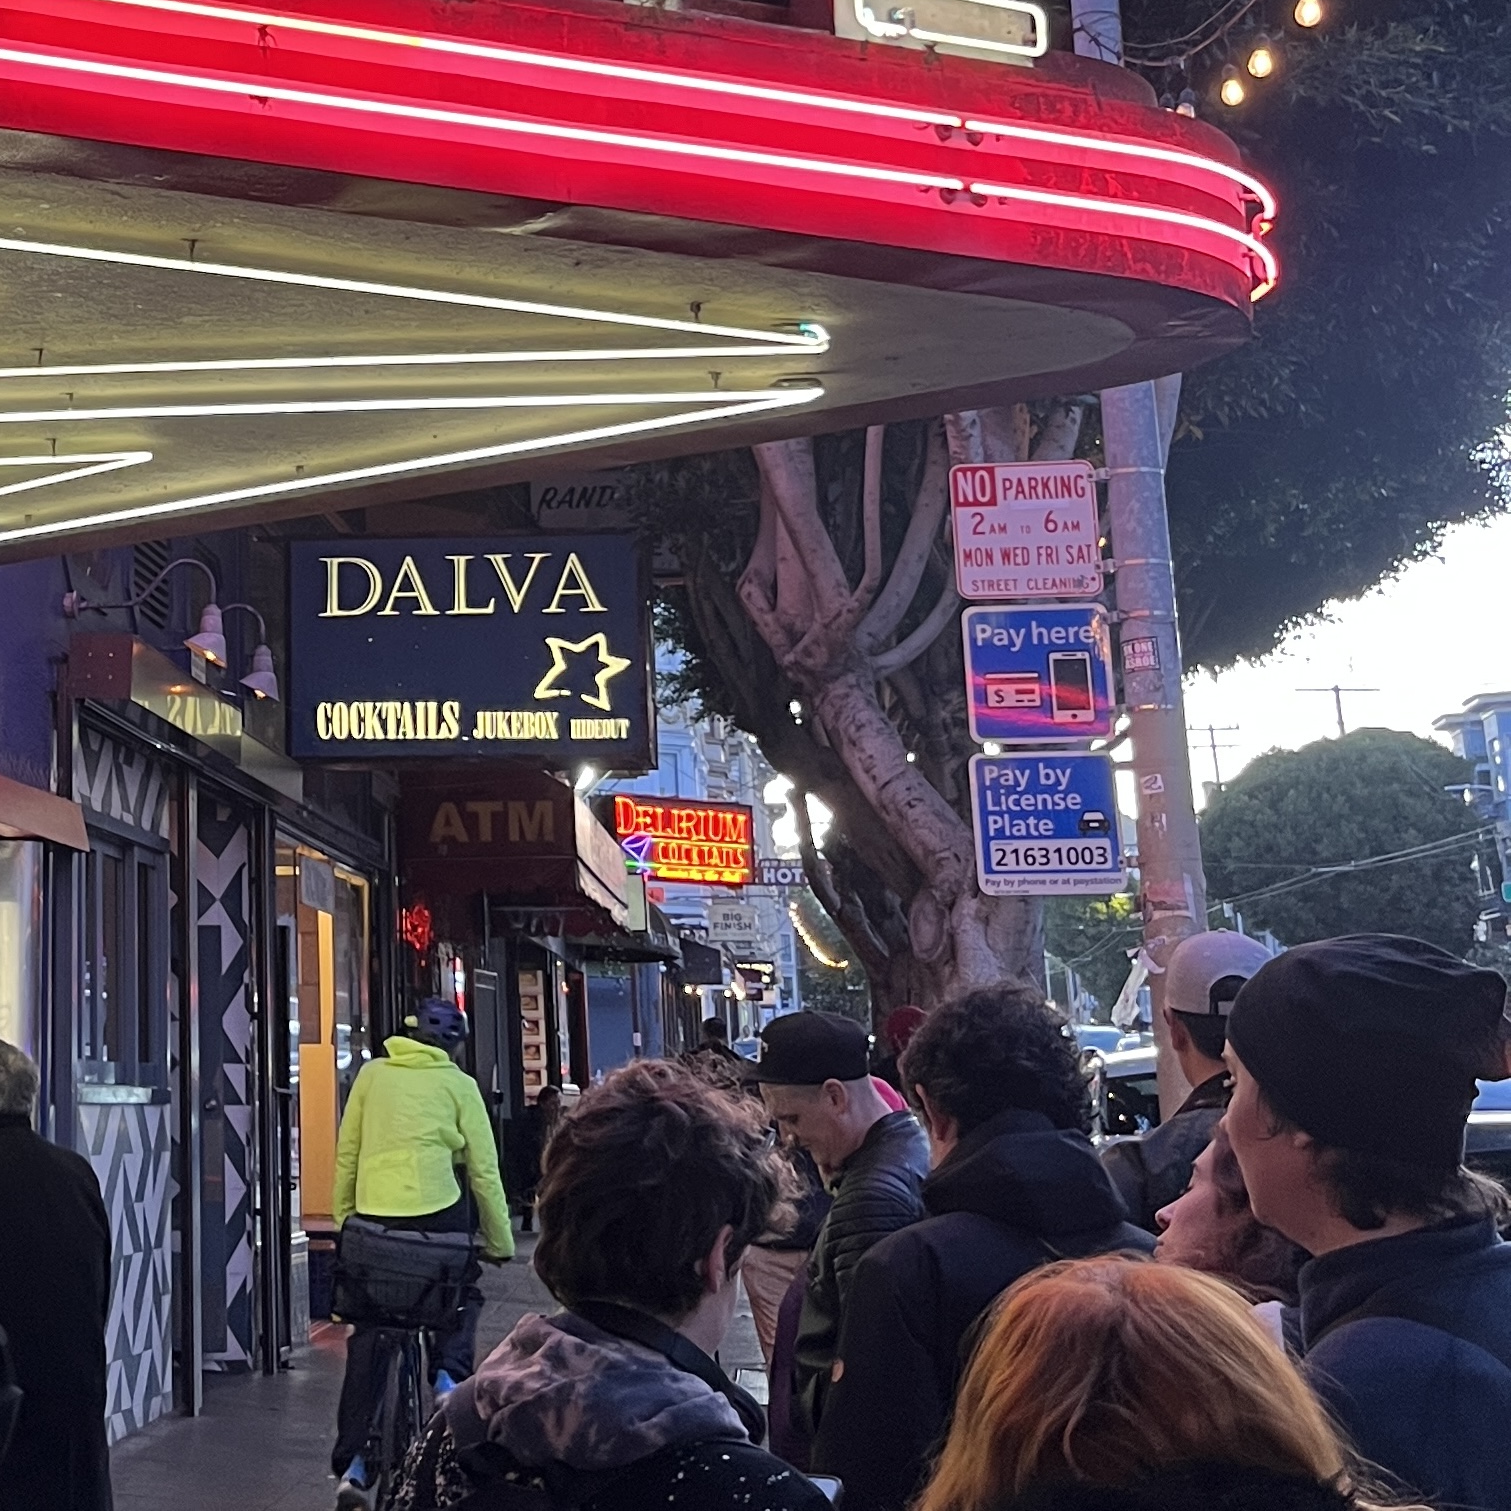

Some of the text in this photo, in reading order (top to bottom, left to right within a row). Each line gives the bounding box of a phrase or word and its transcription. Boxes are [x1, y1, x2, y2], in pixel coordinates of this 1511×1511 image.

[956, 469, 1086, 503] NO PARKING
[963, 544, 1092, 567] MON WED FRI SAT
[317, 552, 608, 617] DALVA
[972, 576, 1089, 592] STREET CLEANING
[975, 621, 1095, 651] Pay here
[317, 701, 630, 740] COCKTAILS JUKEBOX HIDEOUT
[984, 763, 1071, 791] Pay by
[987, 790, 1082, 811] License
[430, 800, 556, 842] ATM
[615, 796, 747, 844] DELIRIUM
[989, 814, 1054, 837] Plate
[658, 842, 745, 867] COCKTAILS
[995, 846, 1108, 867] 21631003
[763, 868, 809, 884] HOT
[986, 878, 1001, 887] Pay
[1004, 877, 1015, 887] by
[1017, 877, 1046, 888] phone
[1061, 877, 1071, 885] at
[1073, 876, 1122, 886] paystation
[713, 921, 752, 931] FINISH
[723, 912, 742, 922] BIG
